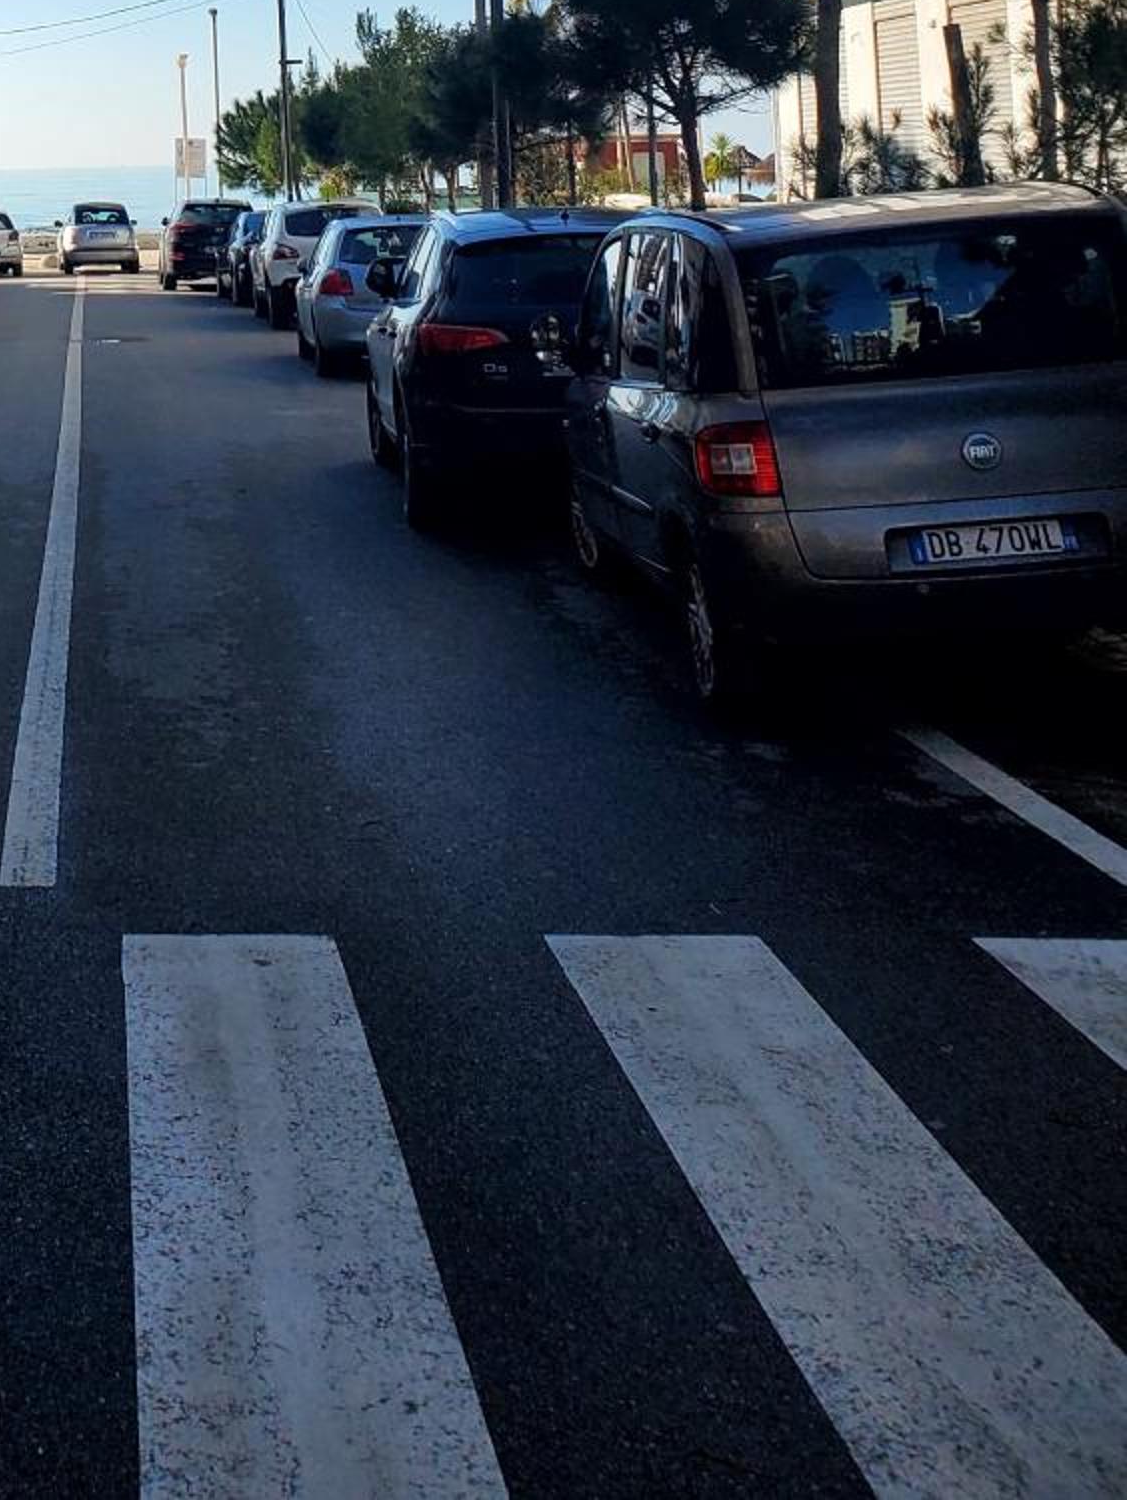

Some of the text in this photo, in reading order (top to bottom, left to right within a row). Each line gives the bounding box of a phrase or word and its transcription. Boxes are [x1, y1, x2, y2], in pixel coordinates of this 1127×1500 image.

[968, 444, 996, 460] FIAT
[926, 530, 963, 560] DB
[976, 523, 1061, 555] 470WL
